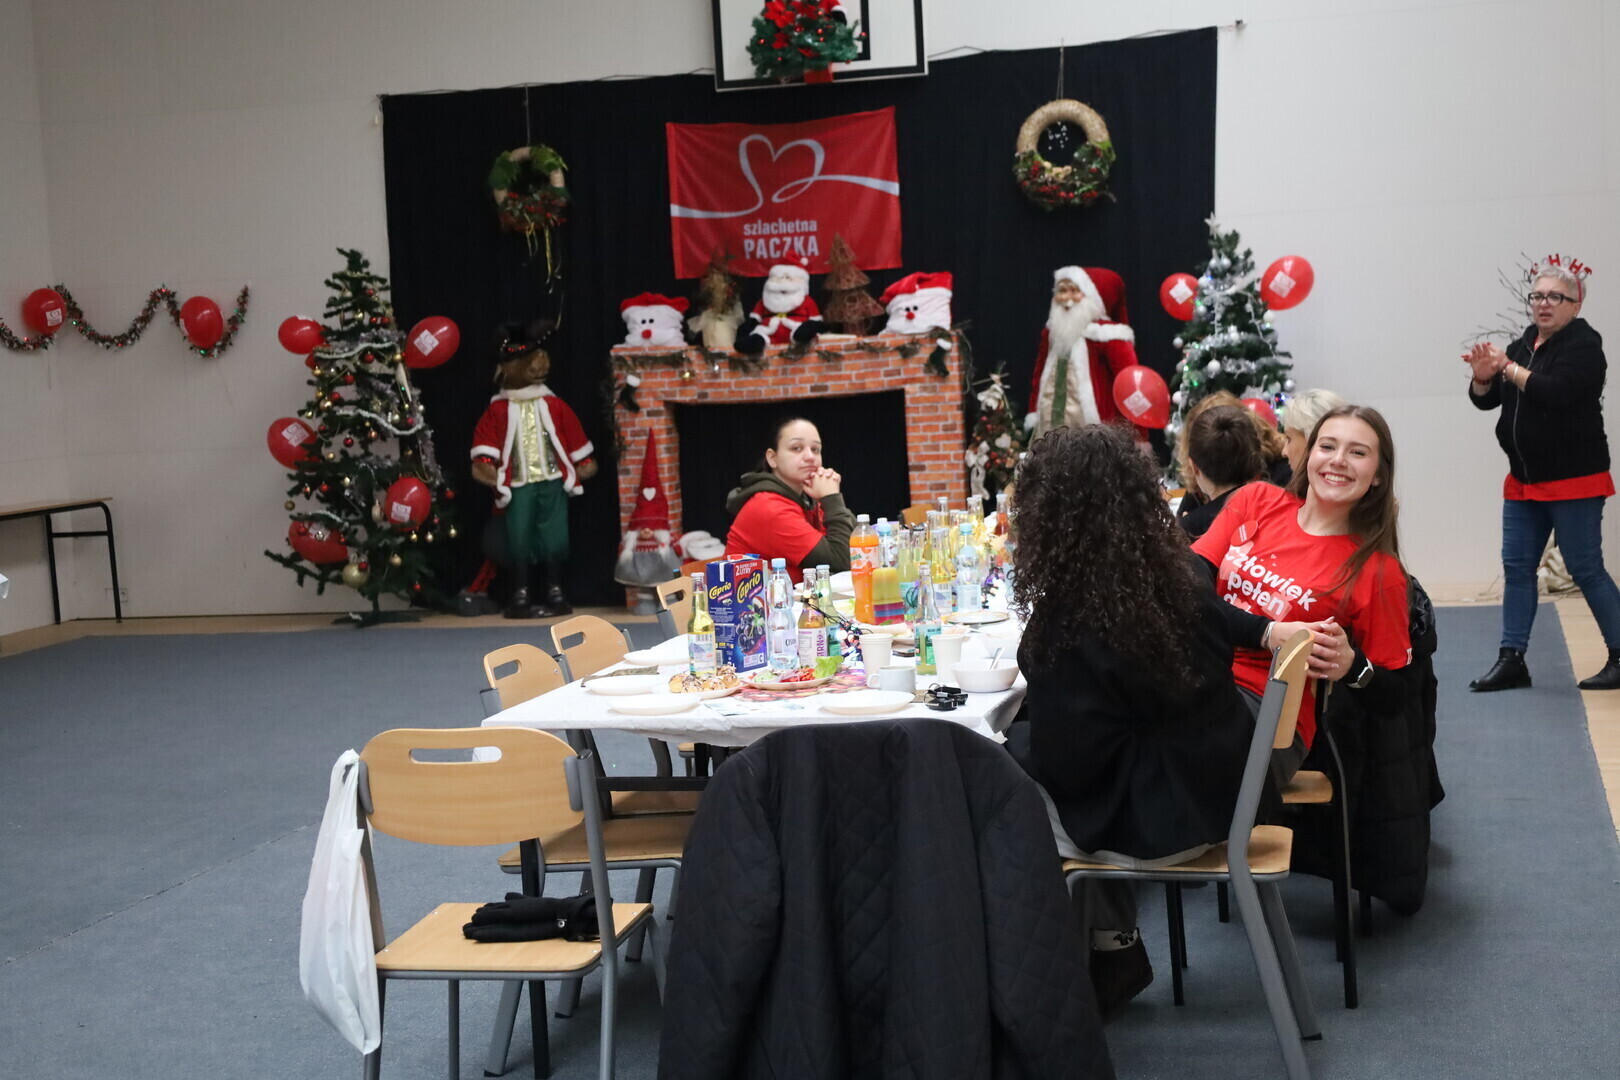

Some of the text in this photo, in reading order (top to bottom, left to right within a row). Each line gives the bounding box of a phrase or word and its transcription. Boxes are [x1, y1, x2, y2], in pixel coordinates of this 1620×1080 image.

[743, 217, 818, 236] szlachetna
[743, 235, 820, 260] PACZKA
[709, 582, 732, 600] Caprio
[737, 572, 761, 603] Caprio
[1225, 544, 1318, 612] człowiek
[1227, 570, 1285, 616] pełen
